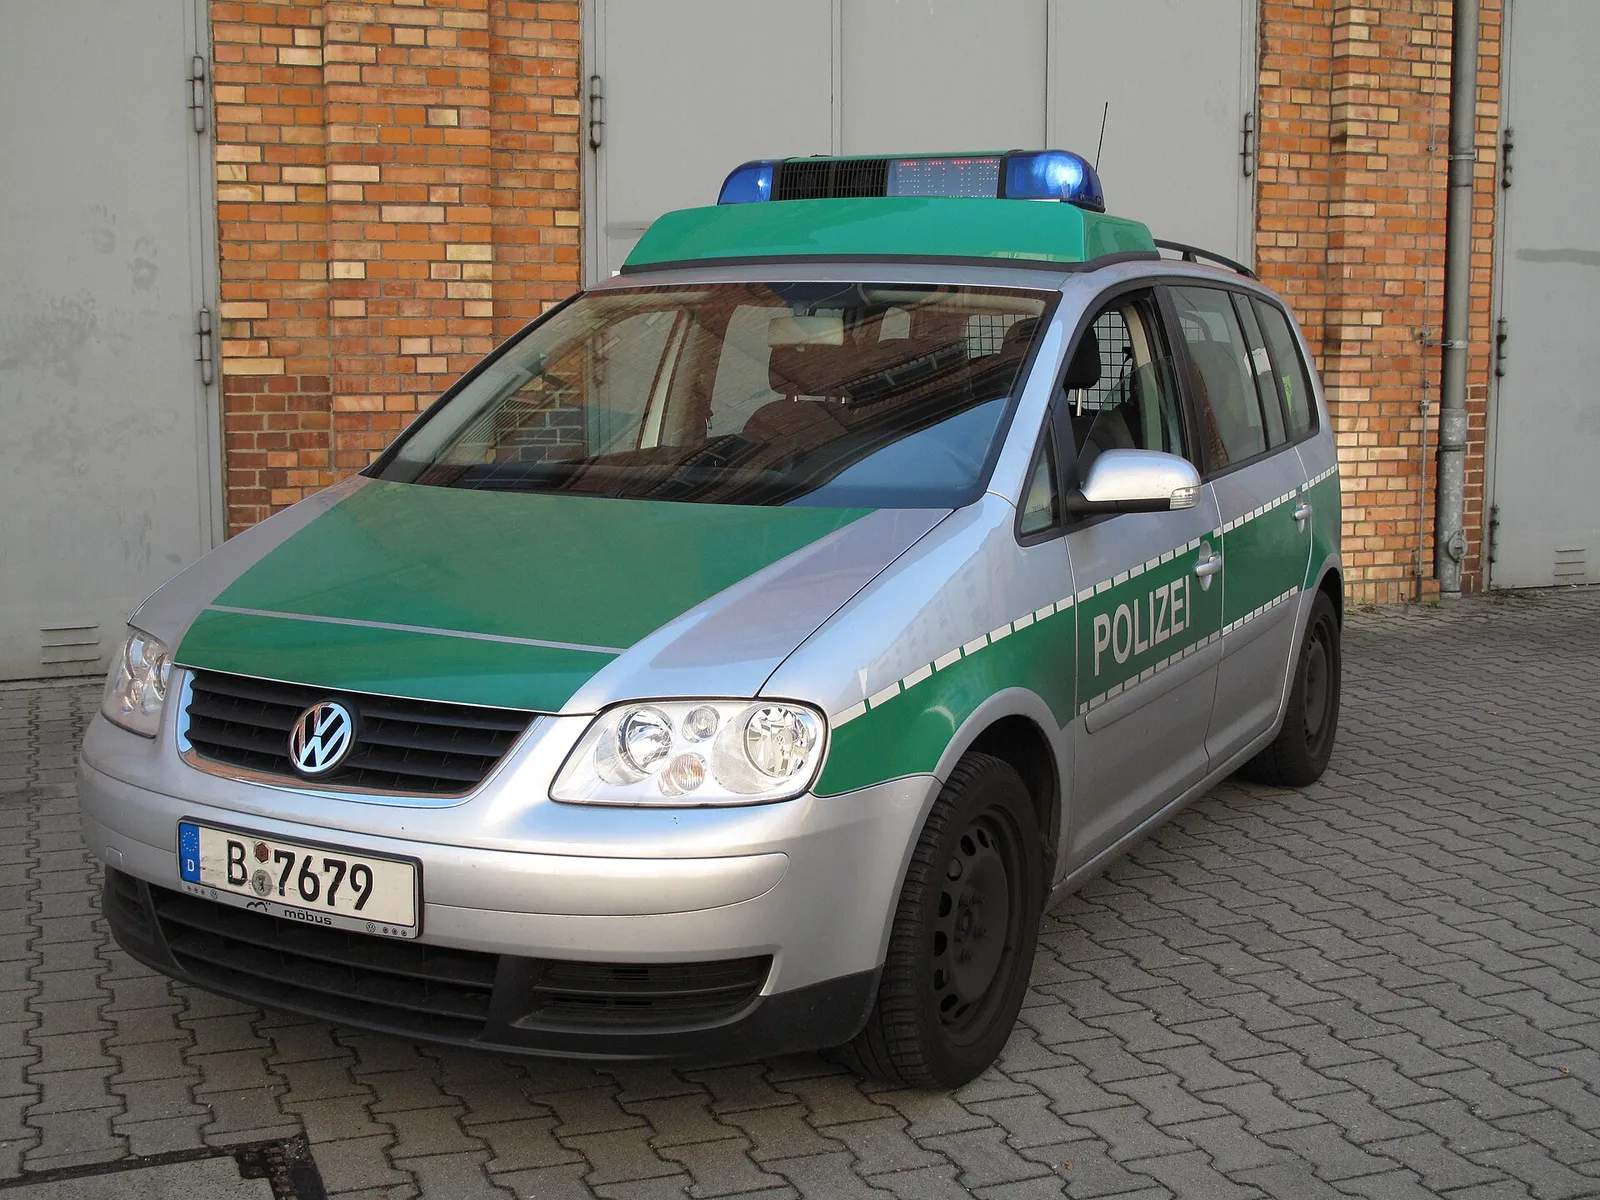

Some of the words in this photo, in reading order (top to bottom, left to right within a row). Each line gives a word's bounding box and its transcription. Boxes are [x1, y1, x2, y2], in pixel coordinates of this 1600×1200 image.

[1093, 574, 1190, 677] POLIZEI
[289, 701, 352, 773] VW
[186, 859, 195, 872] D
[227, 840, 249, 887] B
[273, 849, 374, 911] 7679
[284, 909, 332, 926] möbus
